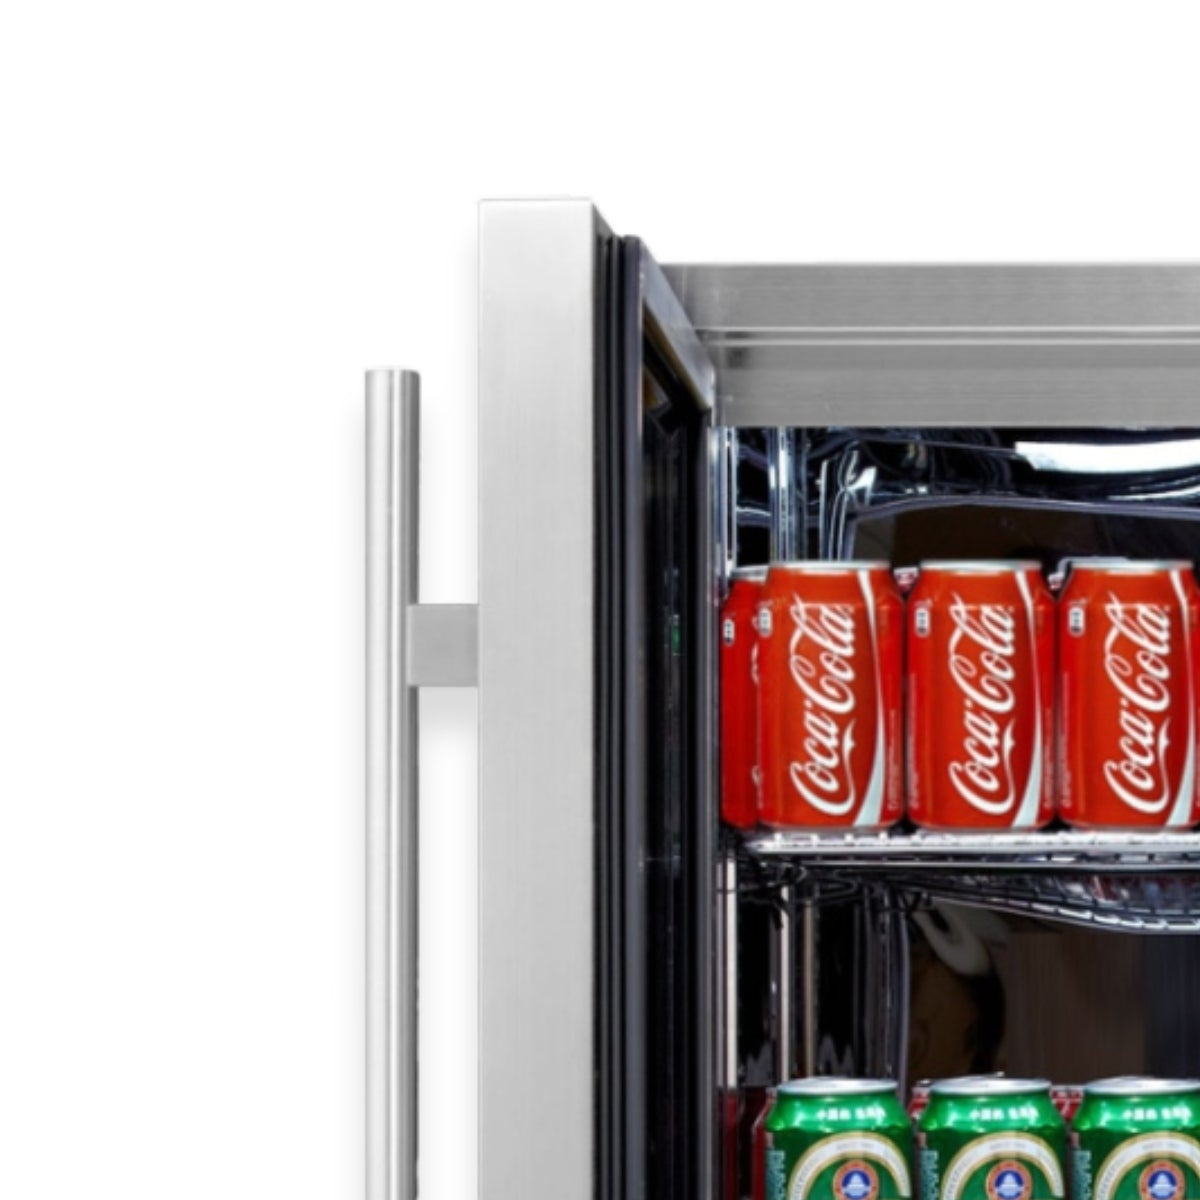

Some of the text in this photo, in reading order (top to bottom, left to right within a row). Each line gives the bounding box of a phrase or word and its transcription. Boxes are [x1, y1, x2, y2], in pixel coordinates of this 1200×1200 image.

[790, 592, 855, 815] Coca-Cola
[949, 592, 1016, 815] Coca-Cola
[1104, 592, 1171, 815] Coca-Cola
